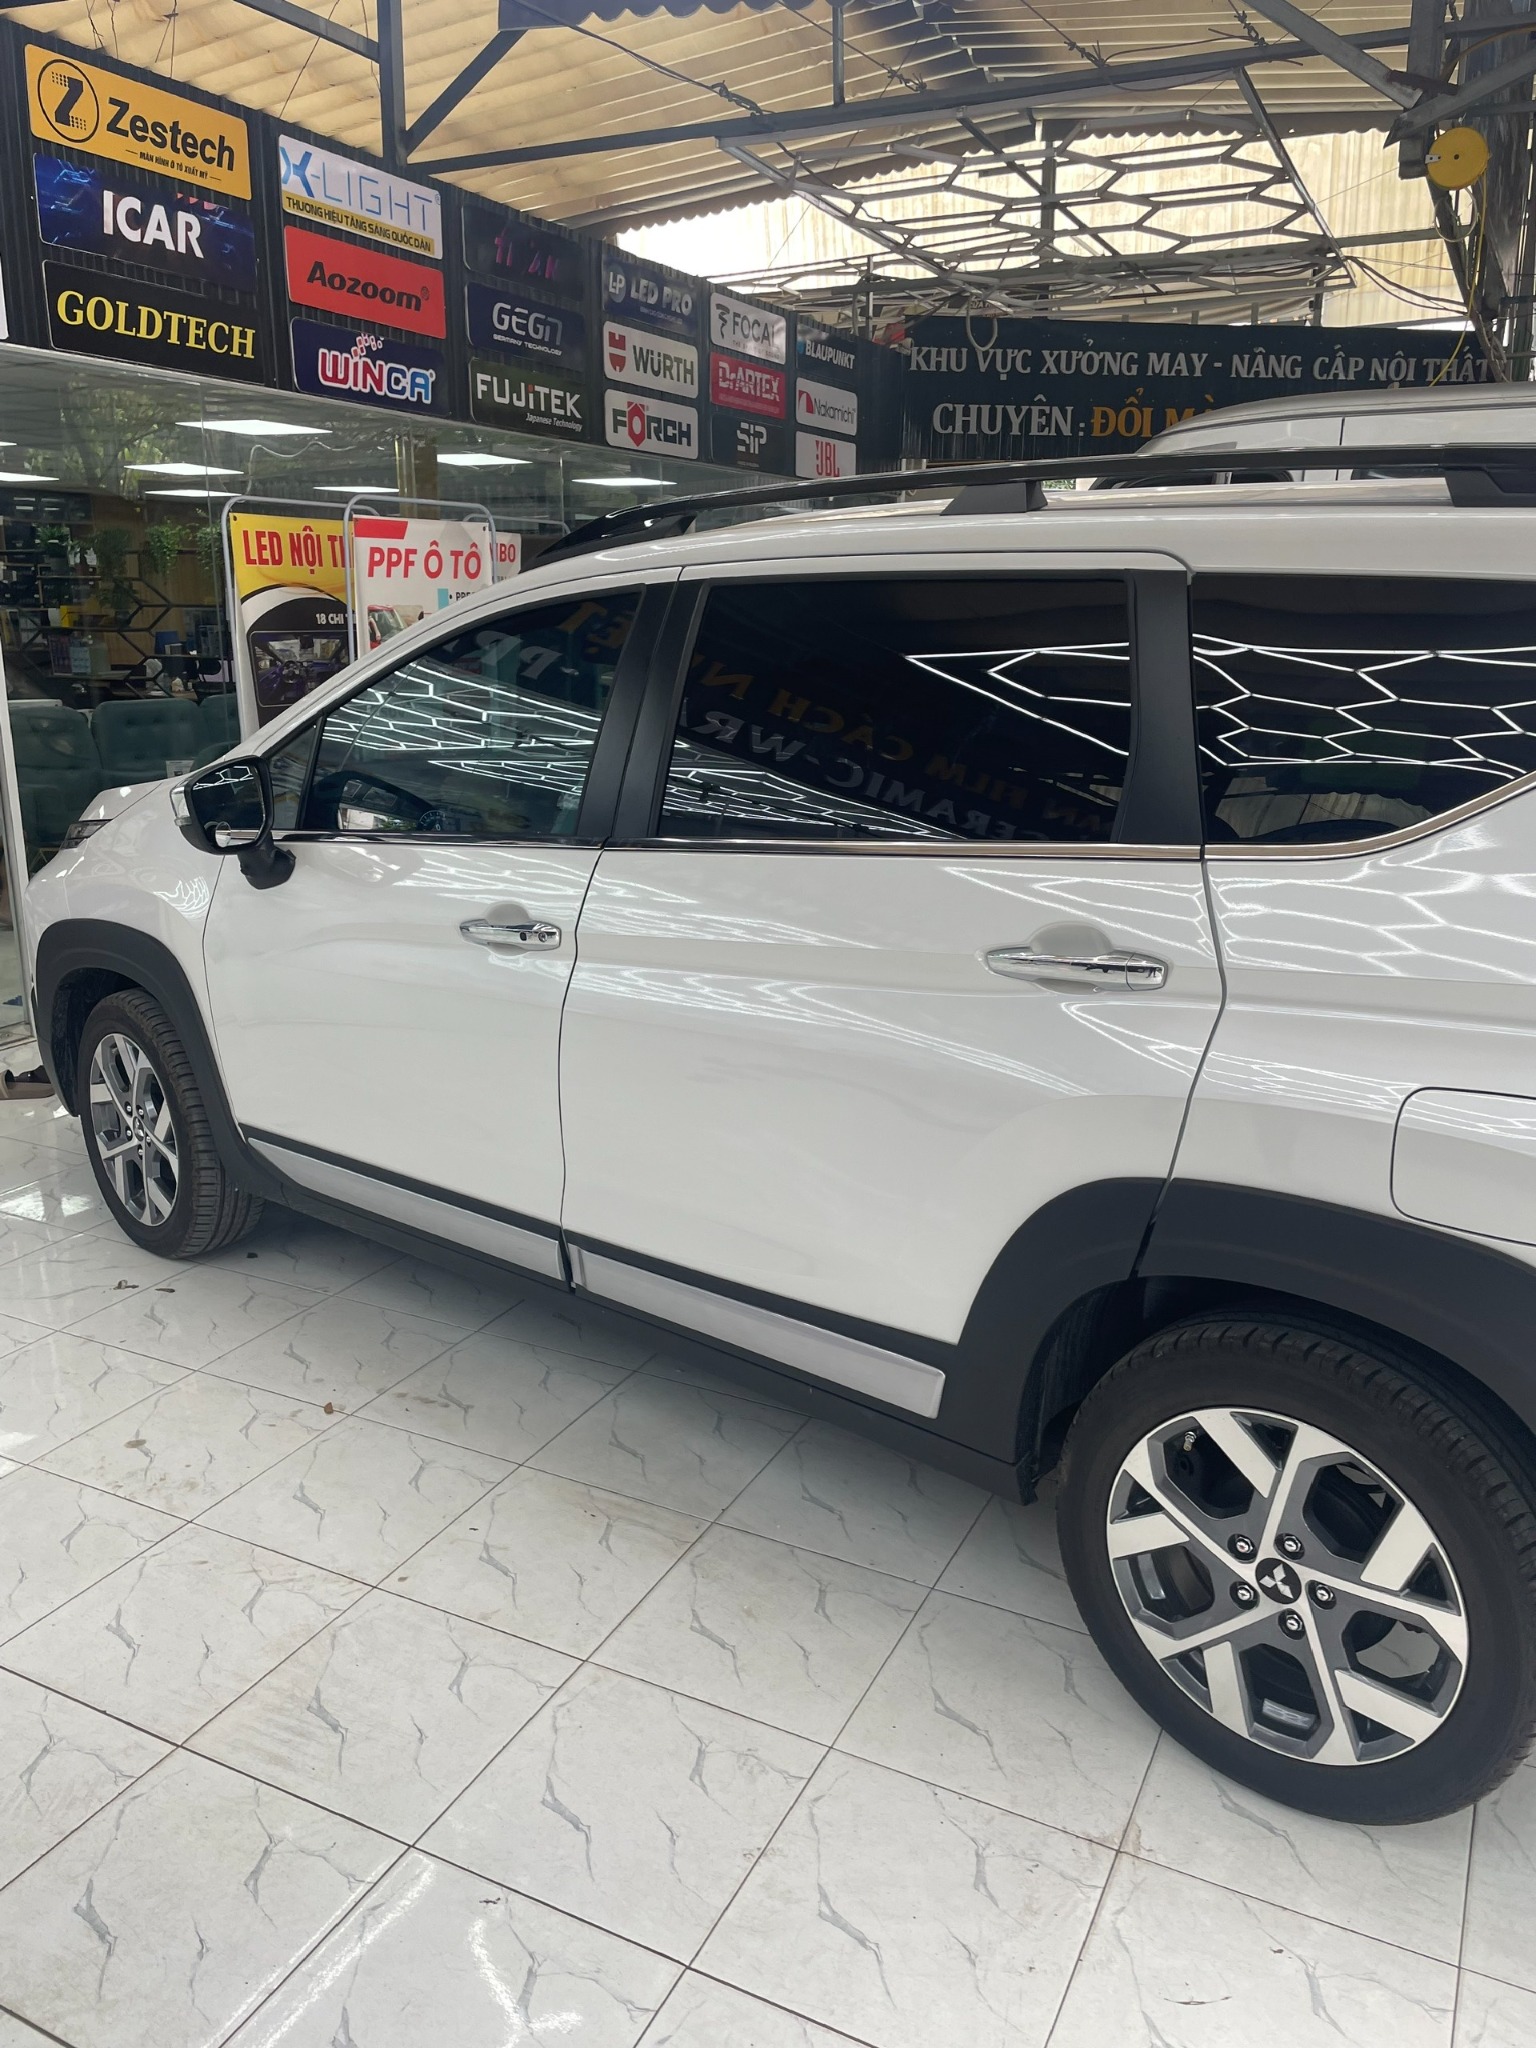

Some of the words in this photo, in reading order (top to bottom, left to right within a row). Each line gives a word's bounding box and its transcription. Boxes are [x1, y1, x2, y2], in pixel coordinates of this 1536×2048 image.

[106, 97, 235, 171] Zestech
[103, 190, 204, 259] ICAR
[307, 260, 422, 312] Aozoom
[630, 277, 659, 305] LED
[662, 286, 692, 316] PRO
[57, 290, 256, 359] GOLDTECH
[632, 344, 695, 386] WÜRTH
[805, 340, 855, 370] BLAUPUNKT
[909, 346, 968, 373] KHU
[974, 348, 1032, 380] VỰC
[1039, 339, 1138, 376] XƯỞNG
[1146, 352, 1208, 377] MAY
[1229, 346, 1302, 380] NÂNG
[1313, 344, 1364, 381] CẤP
[1422, 346, 1488, 382] THẤT
[525, 412, 552, 426] Japanese
[553, 417, 583, 432] Technology
[814, 398, 855, 424] Nakamichi
[1090, 387, 1154, 437] ĐỔI
[815, 440, 840, 478] JBL
[242, 530, 283, 566] LED
[289, 525, 323, 574] NỘI
[367, 545, 418, 579] PPF
[423, 539, 443, 579] Ô
[450, 541, 482, 580] TÔ
[316, 613, 327, 625] 18
[328, 613, 344, 625] CHI
